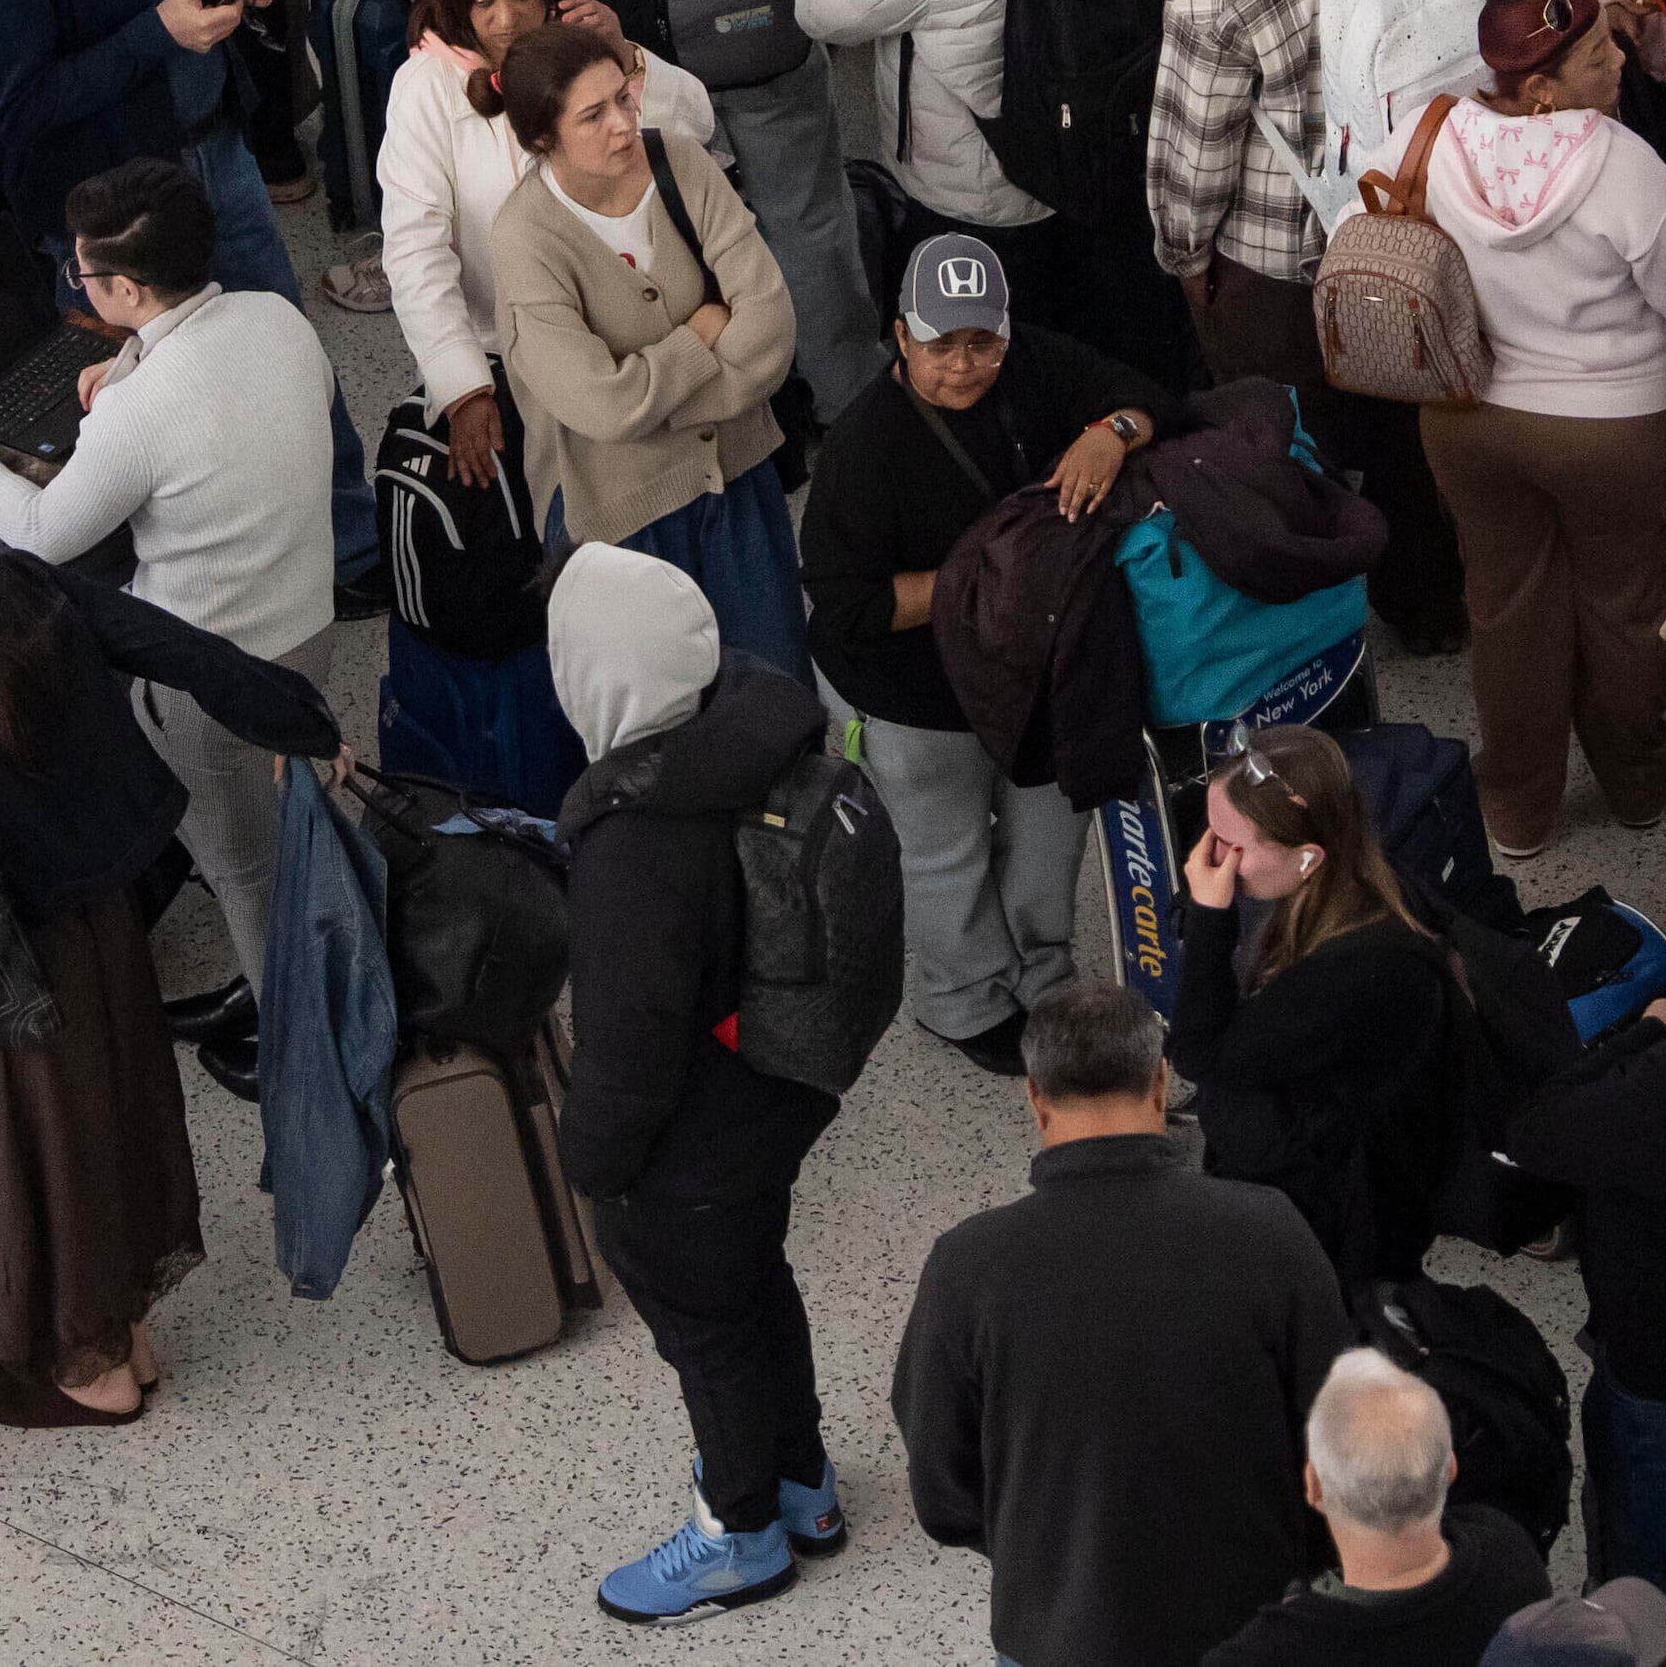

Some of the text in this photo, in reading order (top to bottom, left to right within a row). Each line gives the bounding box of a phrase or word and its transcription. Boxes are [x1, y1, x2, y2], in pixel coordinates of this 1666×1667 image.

[1256, 669, 1334, 728] New York
[1263, 667, 1311, 702] Welcome
